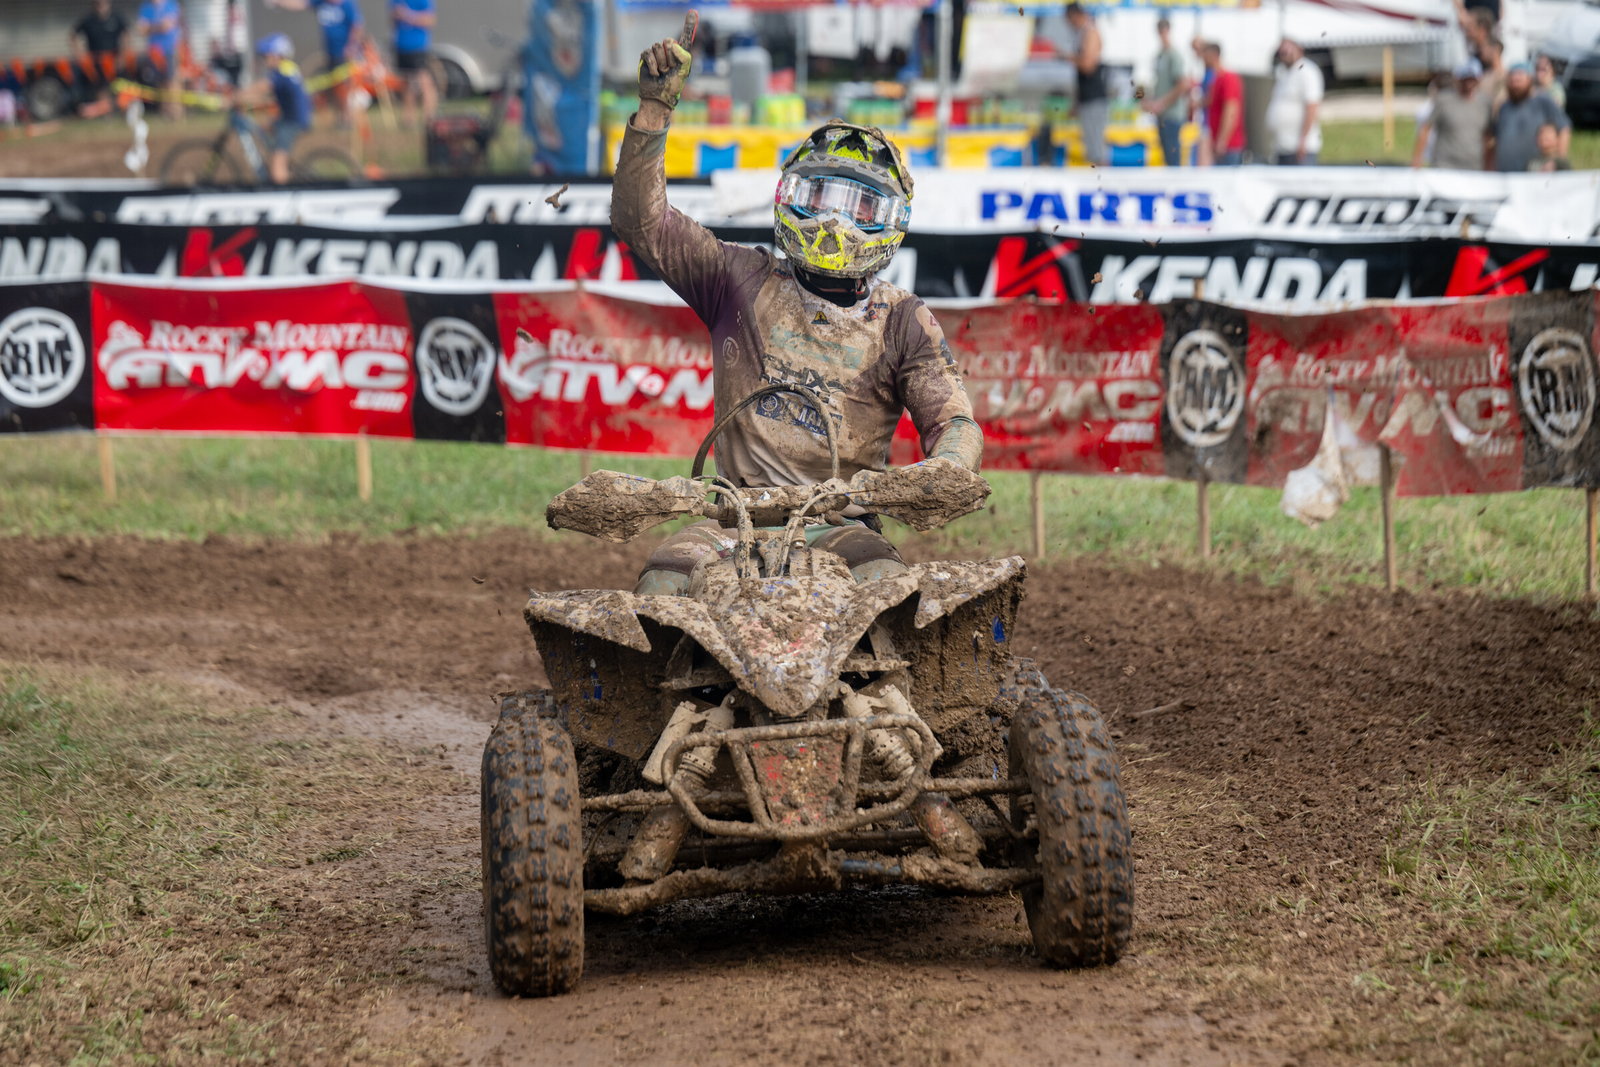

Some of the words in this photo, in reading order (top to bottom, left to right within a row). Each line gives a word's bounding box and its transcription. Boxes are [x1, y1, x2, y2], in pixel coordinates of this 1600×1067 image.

[980, 191, 1214, 223] PARTS
[268, 238, 500, 279] KENDA
[1090, 254, 1368, 303] KENDA
[252, 319, 408, 350] MOUNTAIN
[1026, 345, 1155, 377] MOUNTAIN
